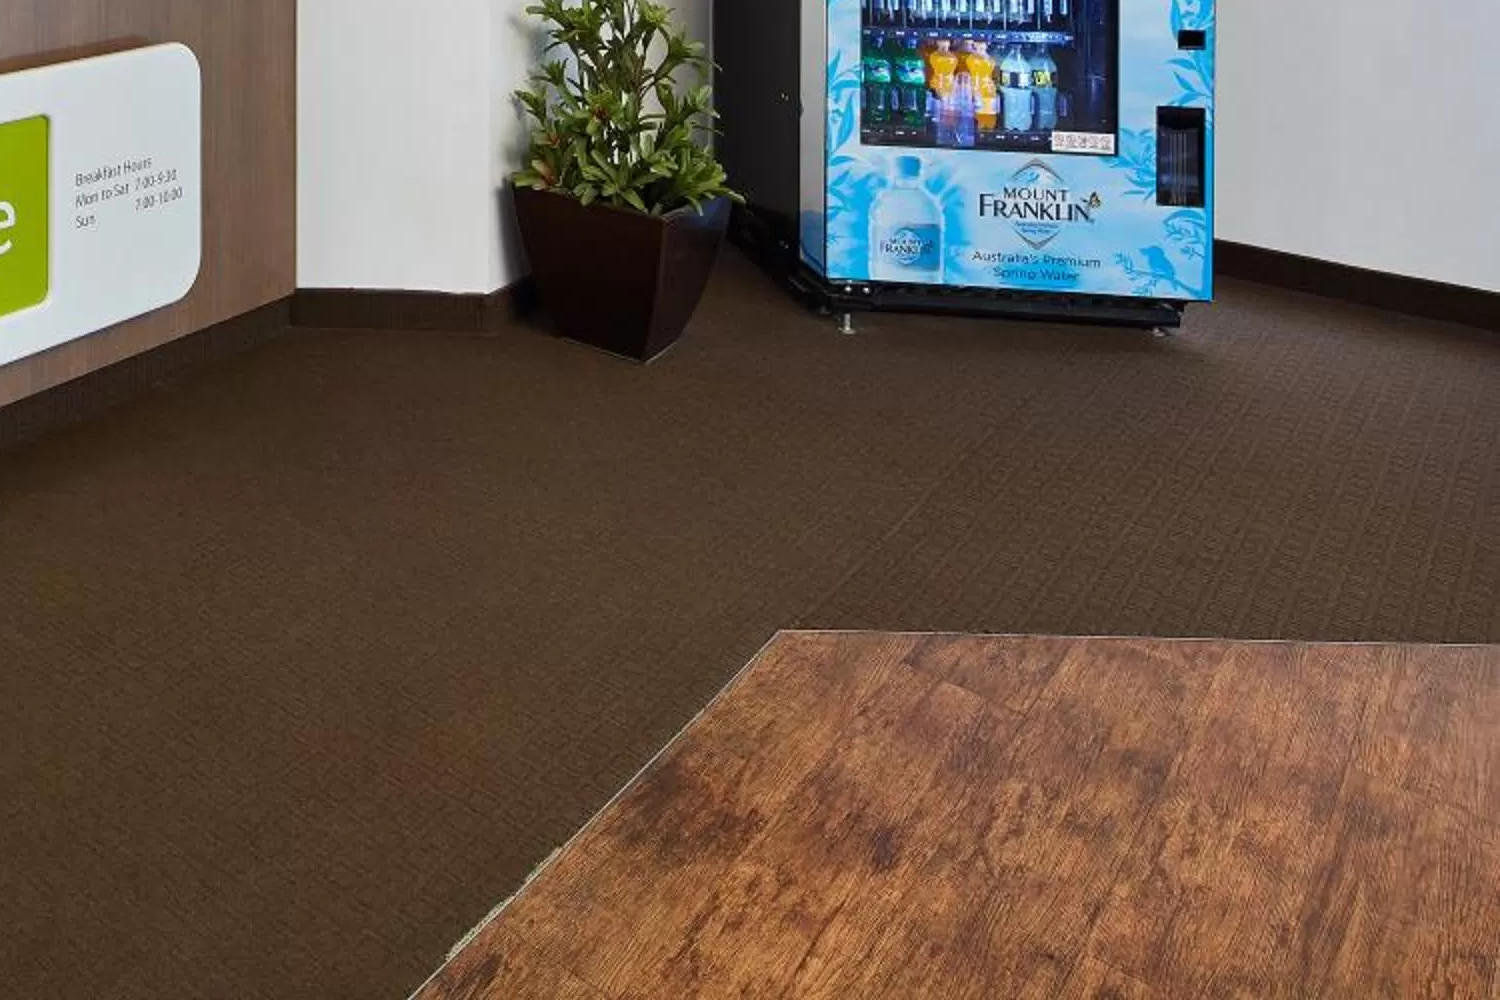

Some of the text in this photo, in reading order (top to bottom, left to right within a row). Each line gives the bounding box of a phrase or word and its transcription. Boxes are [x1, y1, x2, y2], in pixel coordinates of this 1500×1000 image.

[75, 157, 152, 187] Breakfast Hours
[75, 193, 99, 208] Mon
[101, 189, 112, 201] to
[113, 183, 129, 197] Sat
[1003, 186, 1069, 202] MOUNT
[979, 193, 1090, 222] FRANKLIN
[76, 215, 97, 229] Sun
[972, 251, 1101, 268] Australia's Premium
[993, 266, 1080, 281] Spring Water
